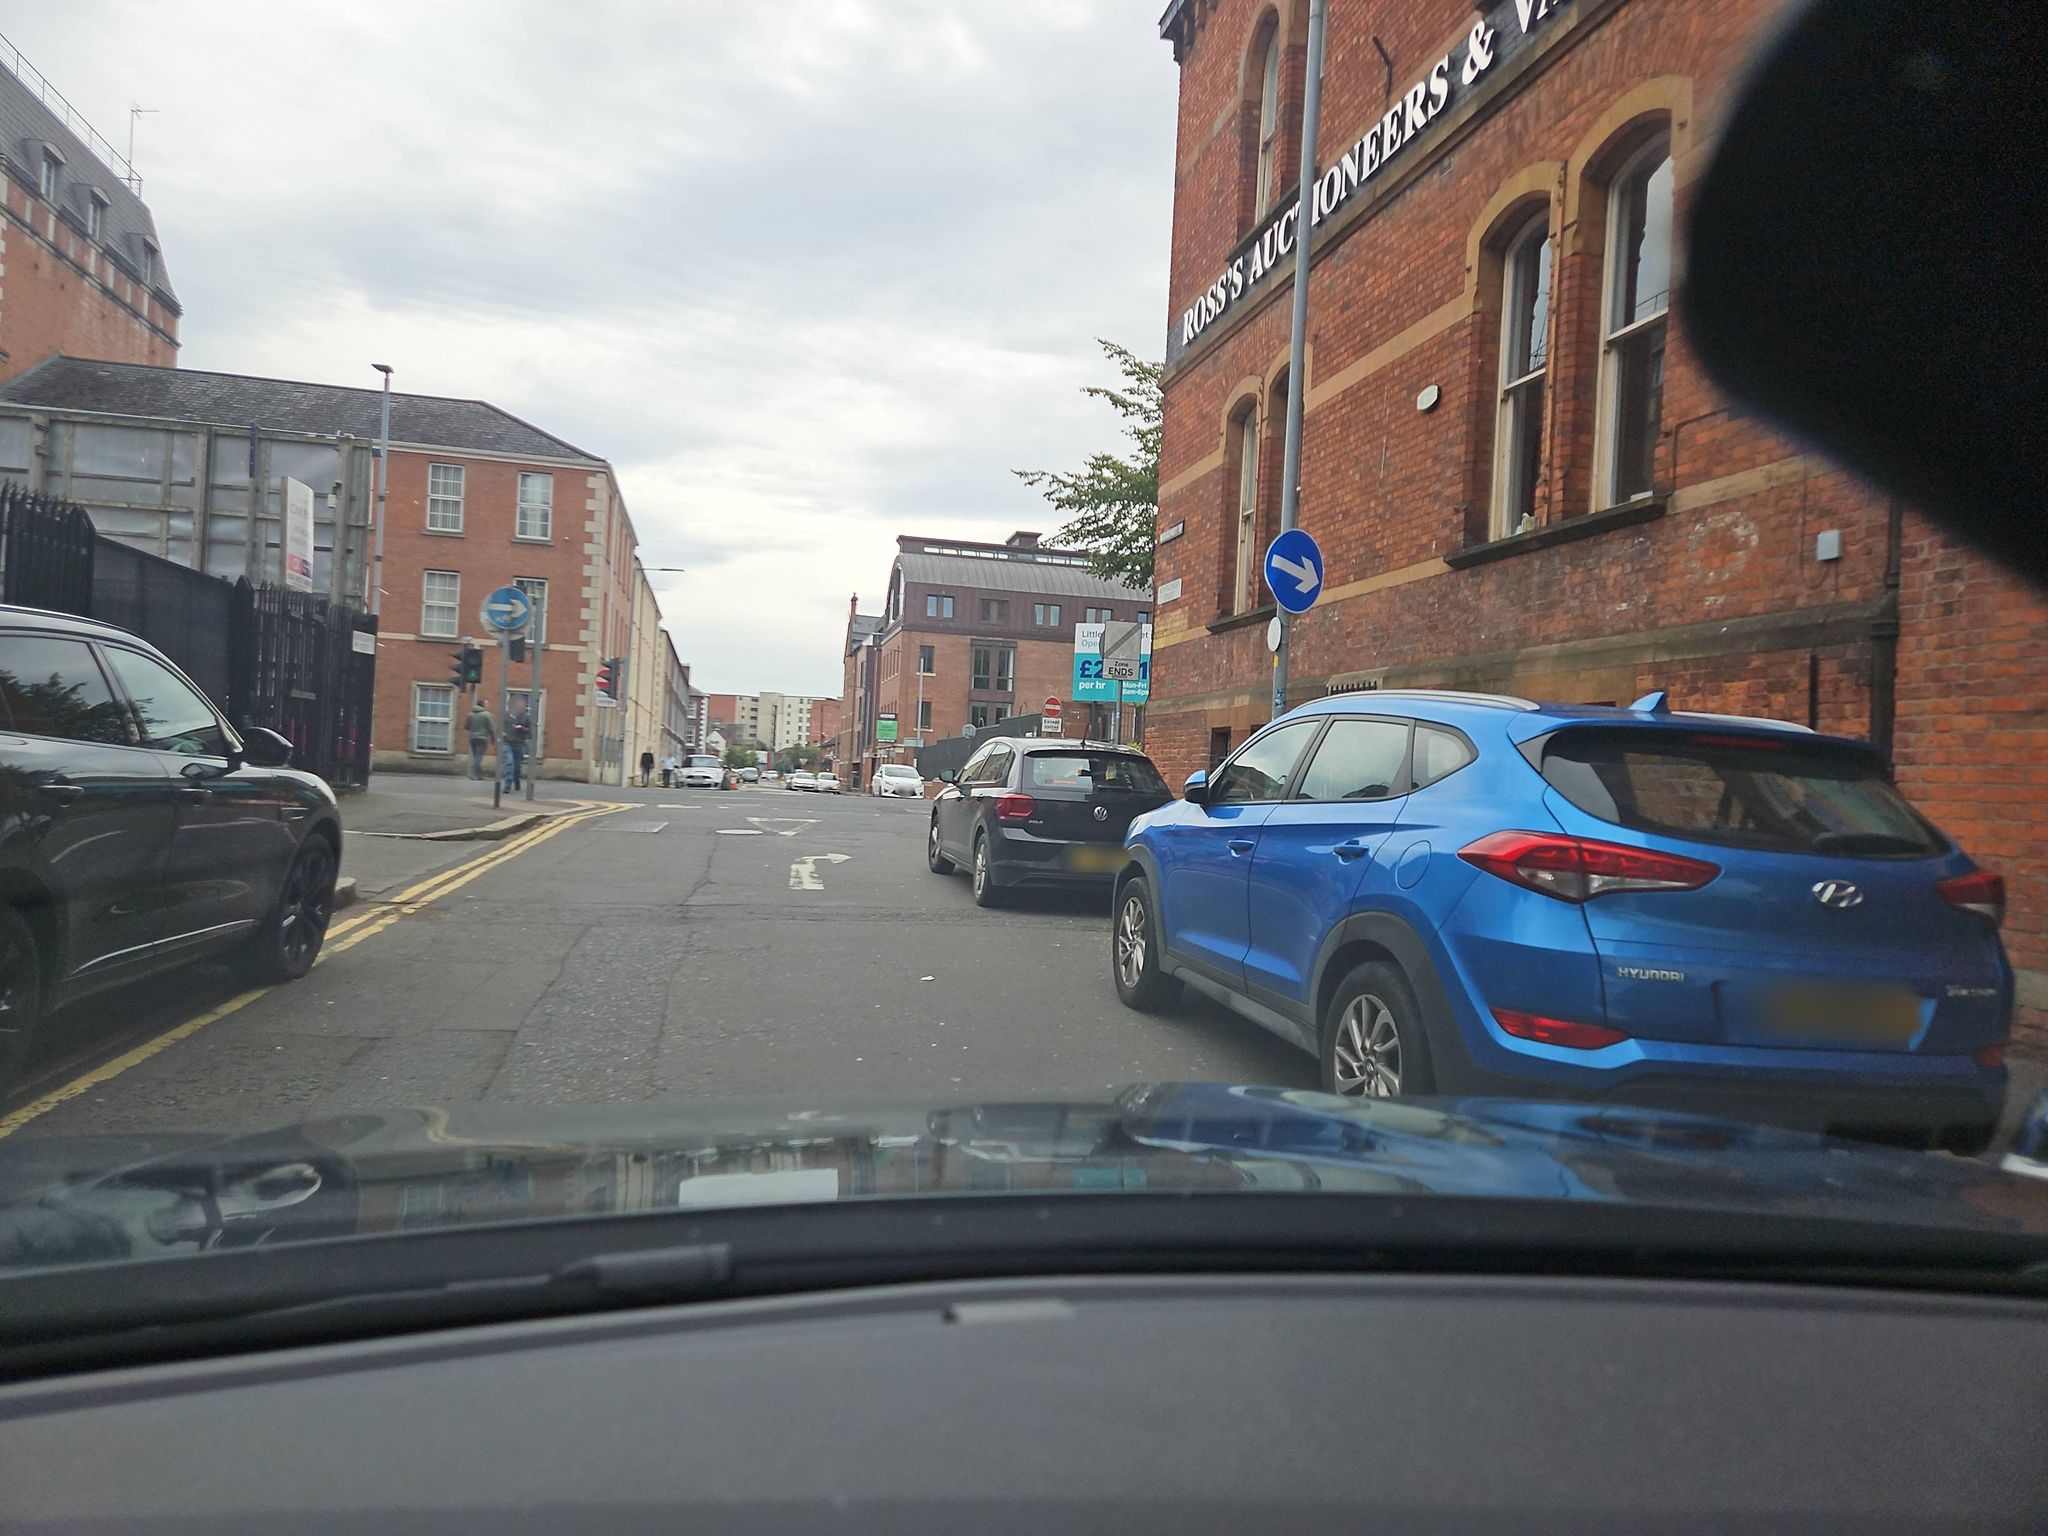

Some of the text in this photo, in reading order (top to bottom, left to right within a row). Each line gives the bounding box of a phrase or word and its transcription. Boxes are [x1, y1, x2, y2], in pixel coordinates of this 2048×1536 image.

[1182, 256, 1244, 346] ROSS'S
[1249, 54, 1449, 285] AUCIONEERS
[1461, 20, 1495, 85] &
[1108, 667, 1134, 677] ENDS
[1078, 681, 1106, 691] per hr
[1617, 967, 1685, 983] HYUNDAI
